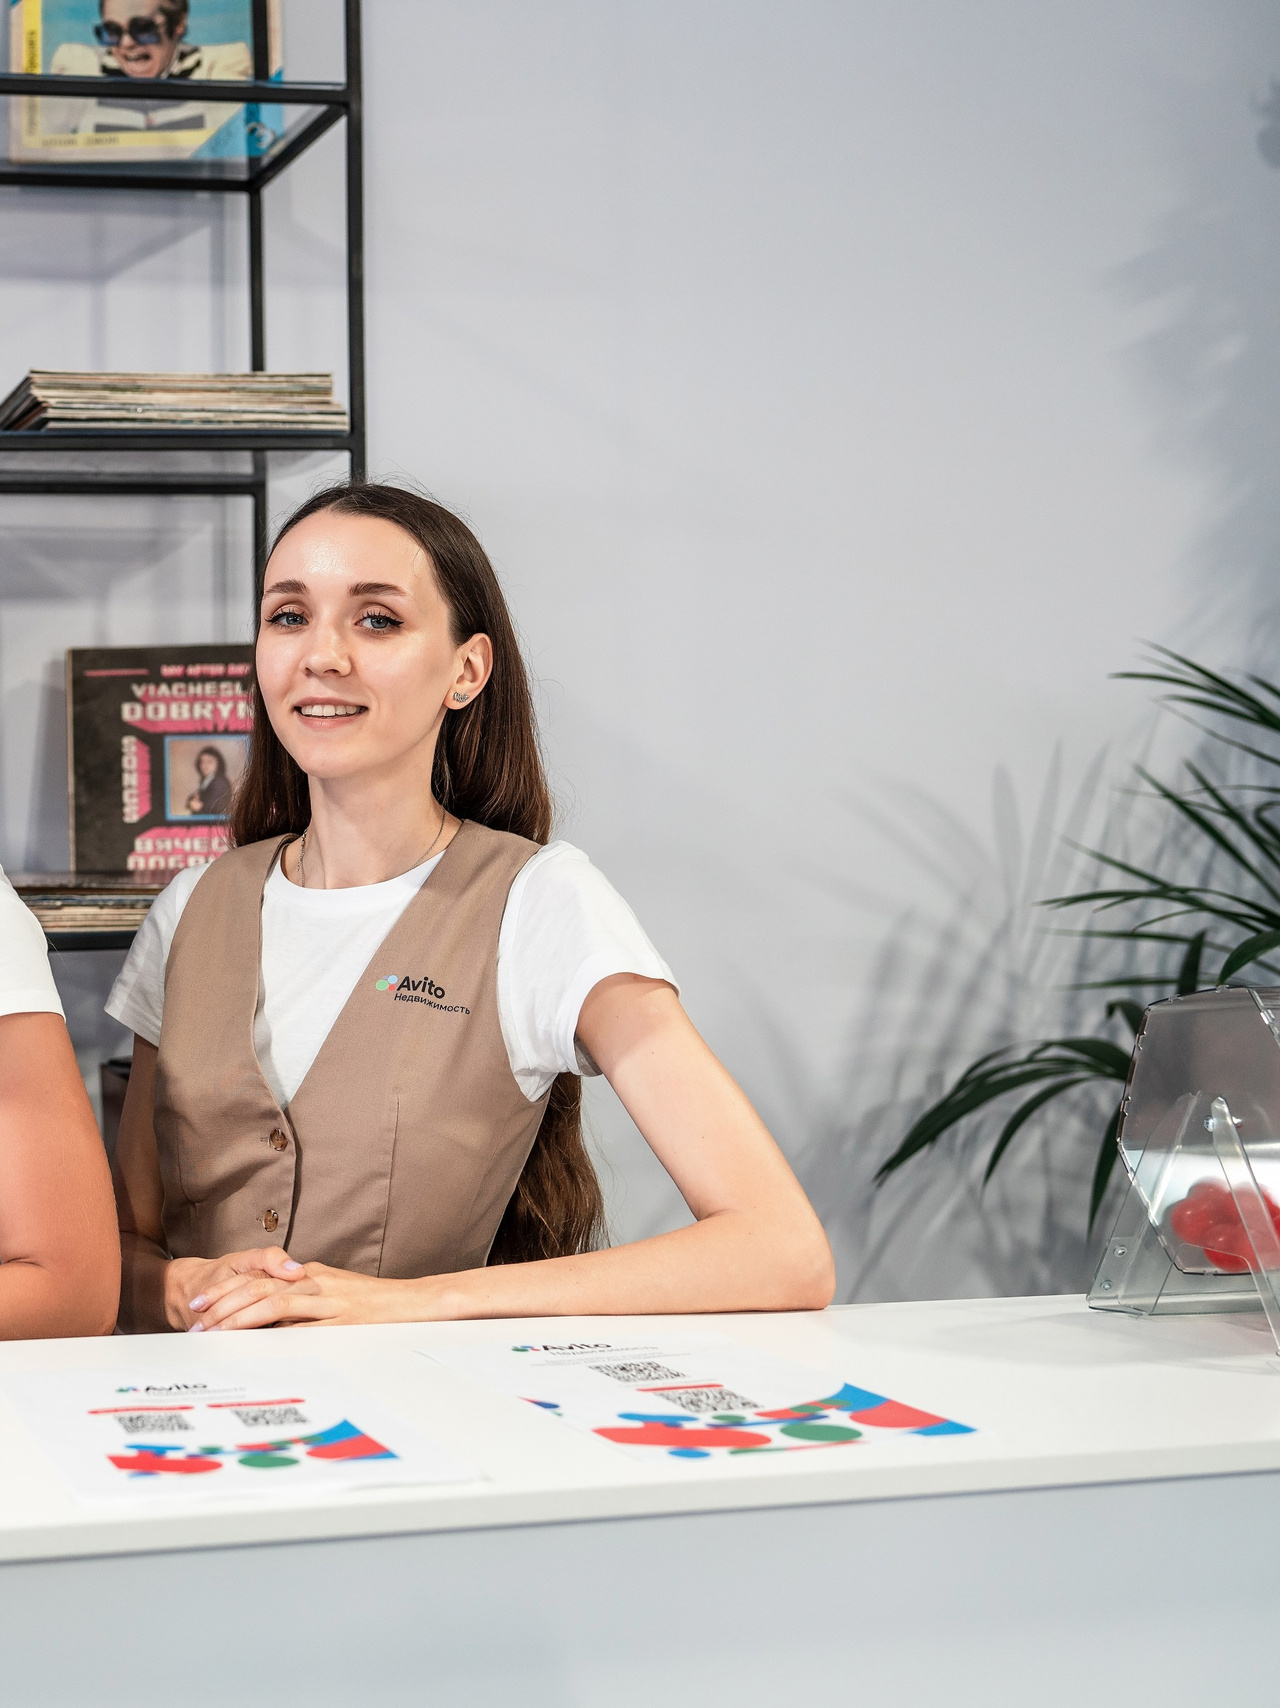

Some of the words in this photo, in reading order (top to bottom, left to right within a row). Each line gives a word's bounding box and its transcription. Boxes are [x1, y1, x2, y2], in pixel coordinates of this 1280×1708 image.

[131, 681, 251, 698] VIACHESL
[121, 700, 255, 722] DOBRYN
[134, 836, 231, 854] ВЯЧЕС
[396, 976, 446, 999] Avito
[393, 992, 471, 1015] Недвижимость
